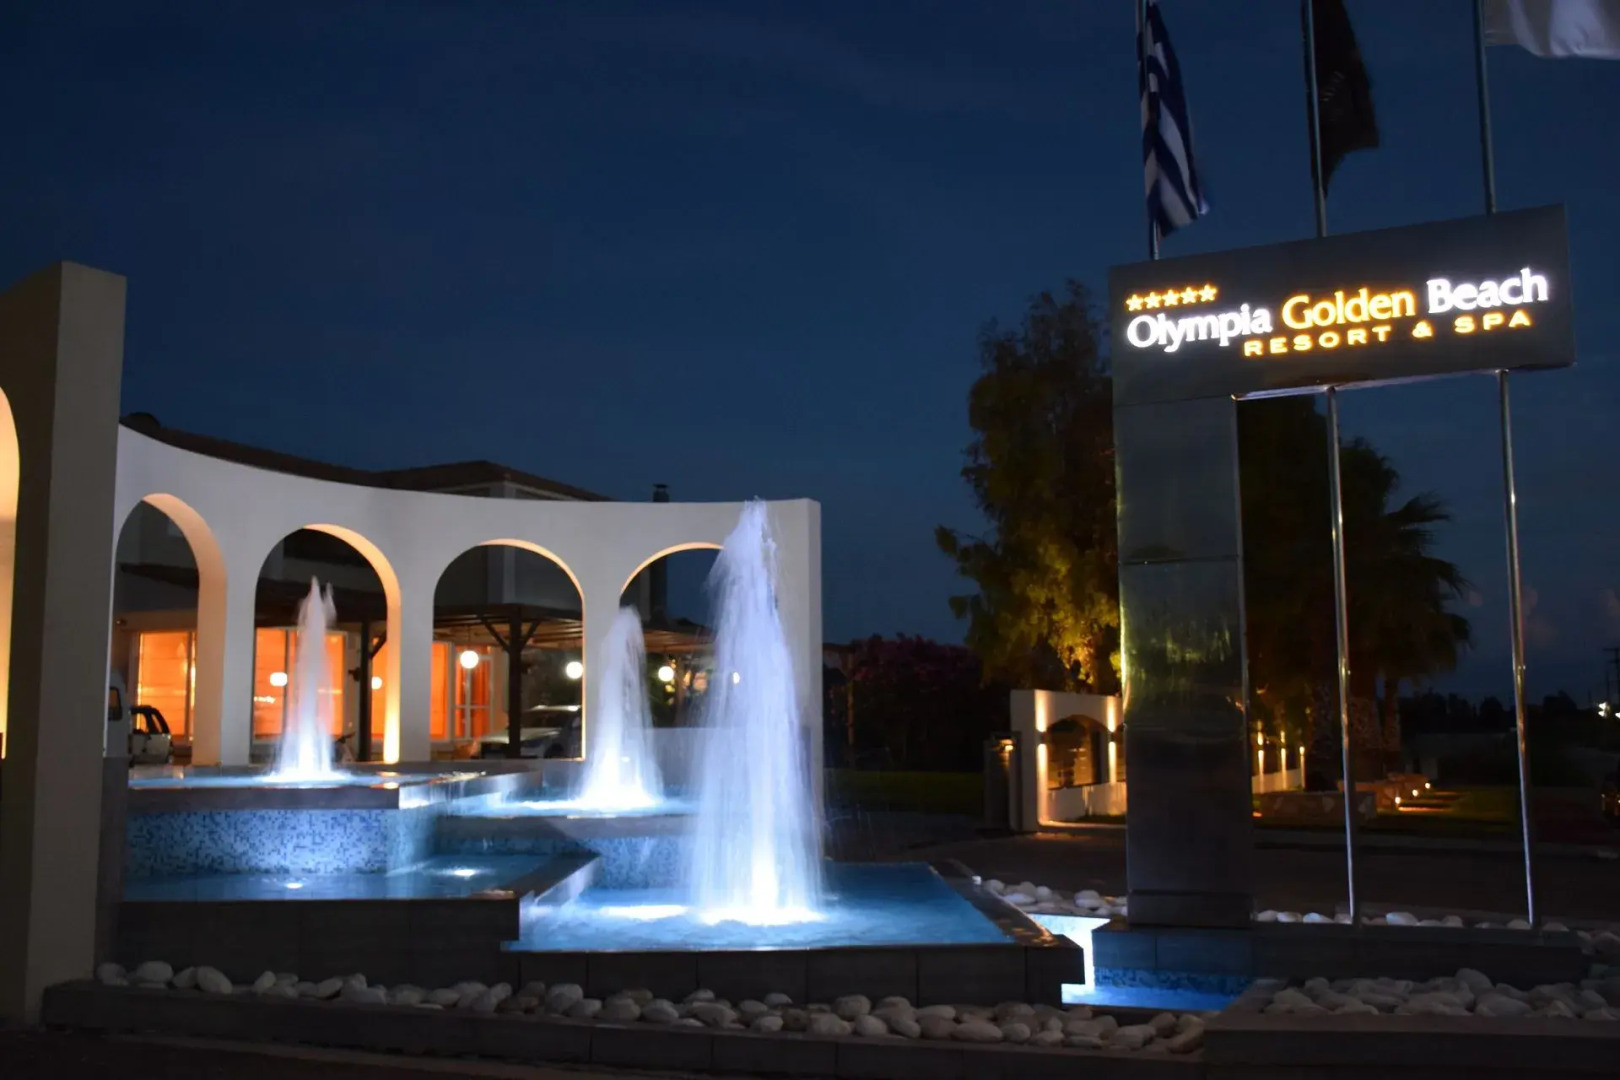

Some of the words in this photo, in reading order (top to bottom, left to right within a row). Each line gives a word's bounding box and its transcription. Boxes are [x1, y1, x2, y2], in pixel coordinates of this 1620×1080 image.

[1127, 303, 1272, 353] Olympia
[1282, 288, 1415, 329] Golden
[1427, 267, 1549, 314] Beach
[1244, 325, 1392, 356] RESORT
[1412, 321, 1434, 338] &
[1455, 310, 1531, 333] SPA
